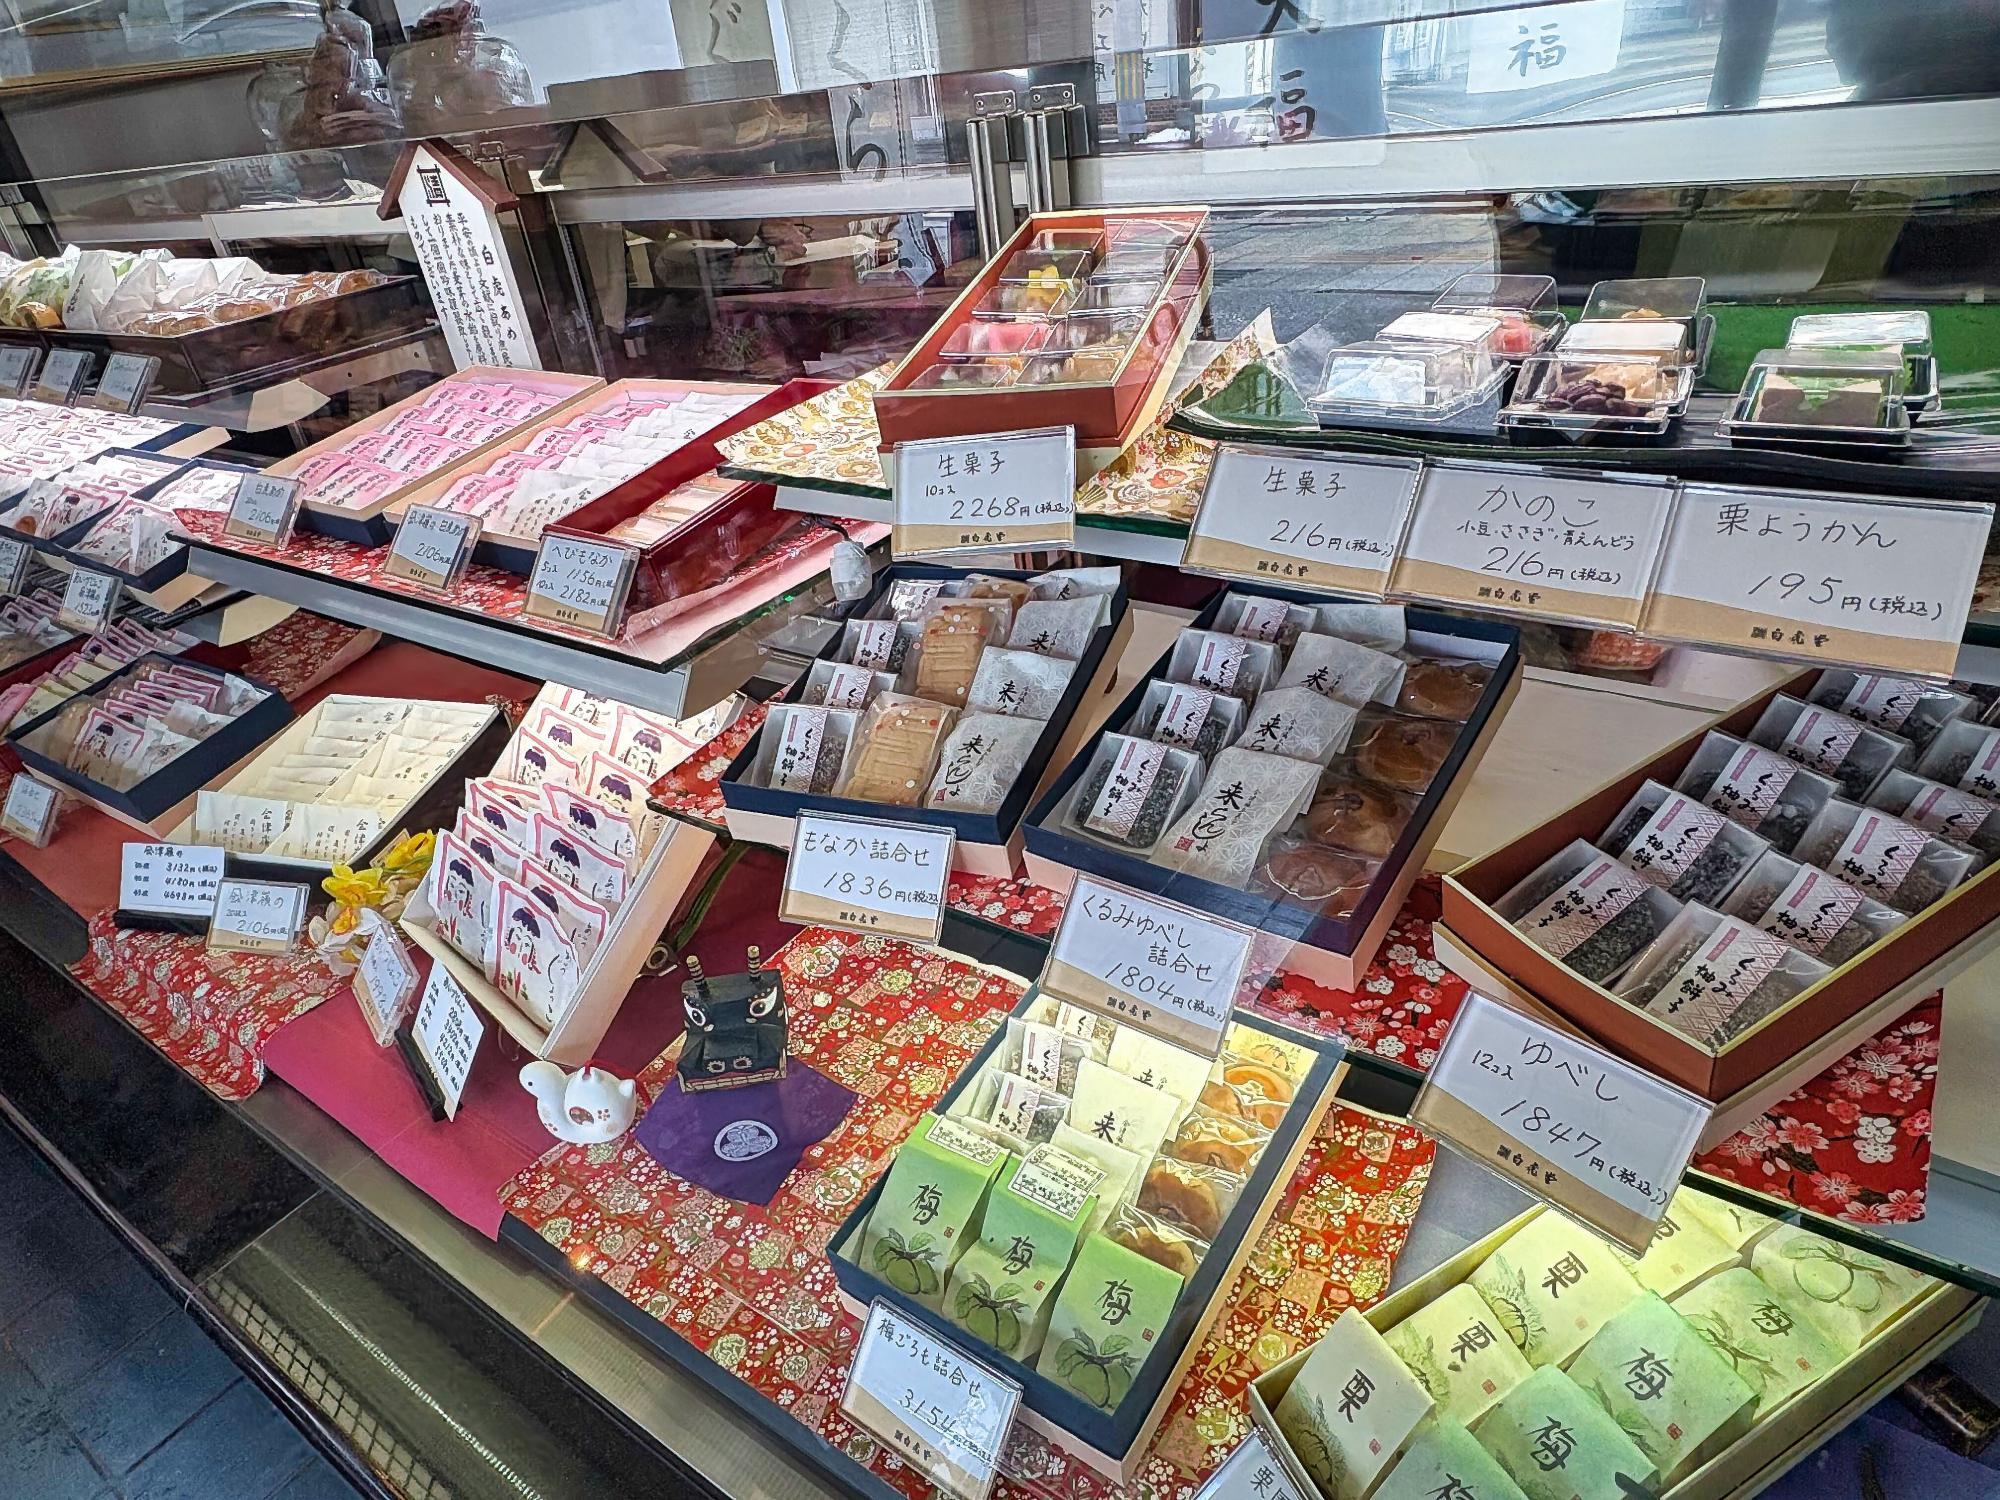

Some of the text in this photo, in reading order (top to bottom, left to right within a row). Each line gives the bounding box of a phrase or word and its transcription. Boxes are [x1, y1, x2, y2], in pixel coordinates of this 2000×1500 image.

[1507, 22, 1567, 77] 福
[481, 245, 518, 341] 白虎あめ
[938, 450, 1006, 478] 生菓子
[1263, 466, 1346, 498] 生菓子
[1478, 484, 1600, 528] かのこ
[1716, 502, 1897, 548] 栗ようかん
[1480, 546, 1622, 585] 216円(税込)
[1748, 572, 1942, 621] 195円(税込)
[803, 831, 930, 866] もなか詰合せ
[1659, 827, 1699, 865] くるみ
[1082, 893, 1191, 949] くるみゆべし
[1579, 887, 1622, 920] くるみ
[1792, 901, 1837, 944] くるみ
[1148, 942, 1214, 983] 詰合せ
[1711, 957, 1756, 1000] くるみ
[1520, 1037, 1619, 1101] ゆべし
[908, 1183, 943, 1225] 梅
[1002, 1233, 1037, 1276] 梅
[1541, 1250, 1588, 1299] 栗
[1094, 1278, 1133, 1326] 梅
[1752, 1299, 1798, 1338] 梅
[877, 1318, 982, 1400] 梅ごろも詰合せ
[1450, 1320, 1497, 1362] 栗
[1618, 1345, 1675, 1401] 梅
[1337, 1367, 1376, 1424] 栗
[1527, 1414, 1578, 1472] 梅
